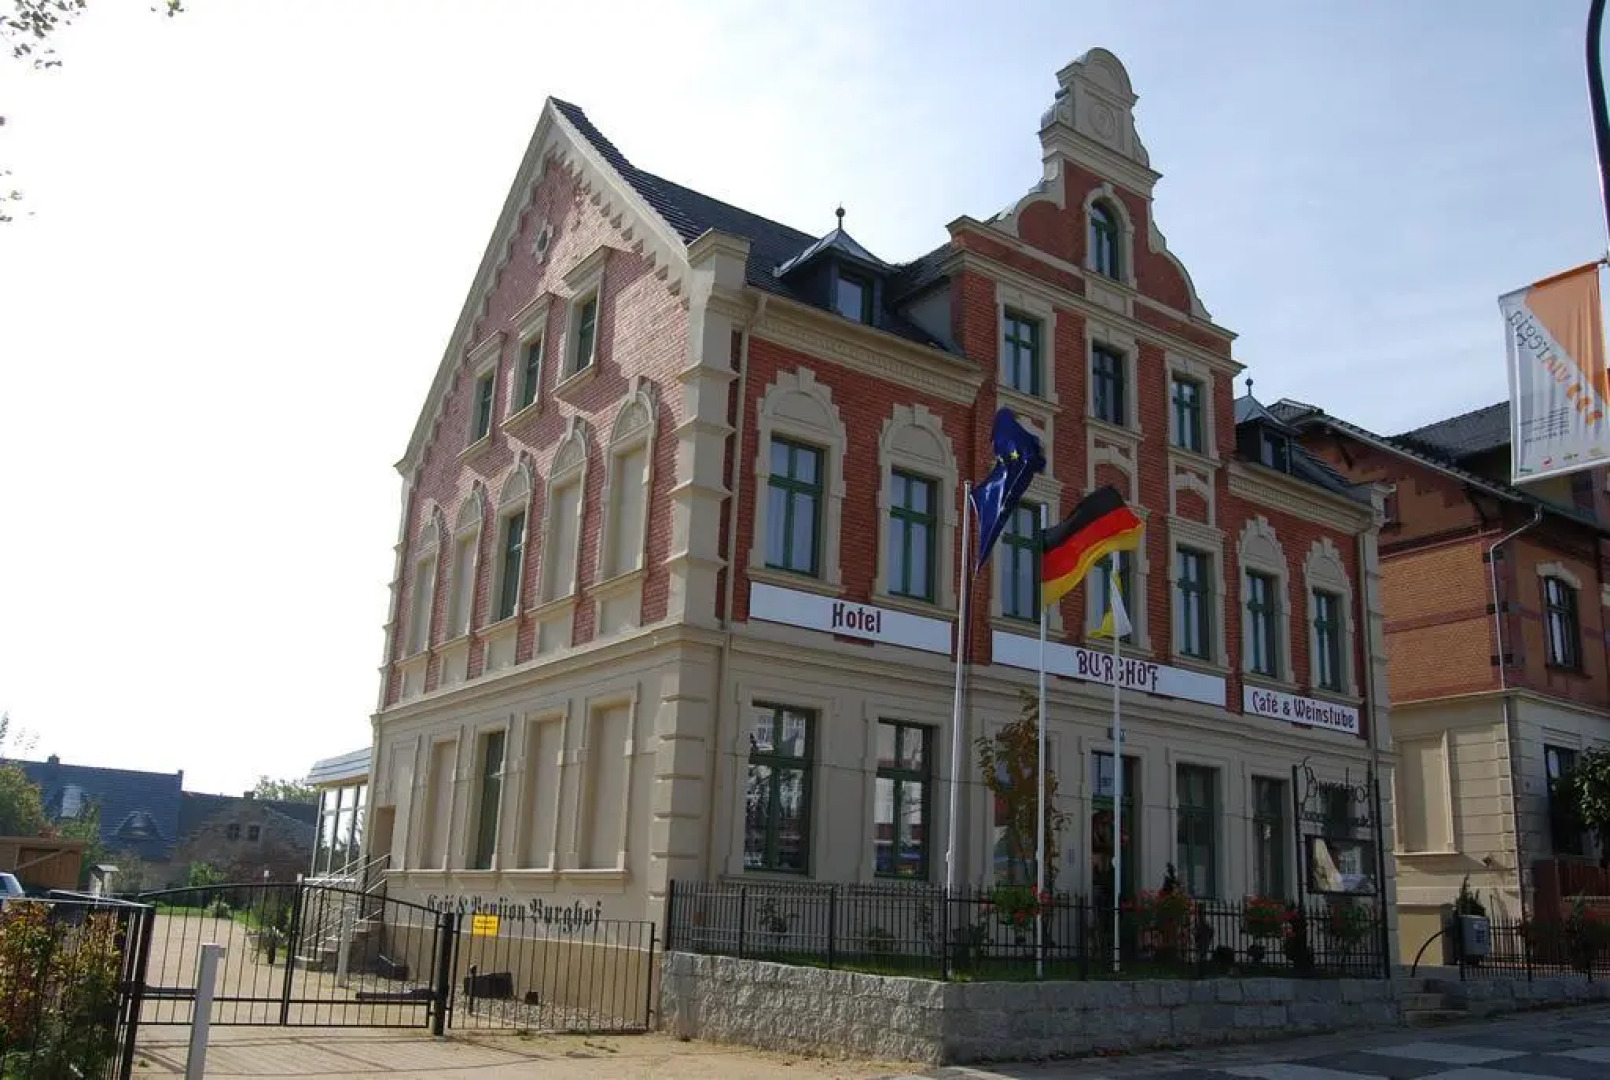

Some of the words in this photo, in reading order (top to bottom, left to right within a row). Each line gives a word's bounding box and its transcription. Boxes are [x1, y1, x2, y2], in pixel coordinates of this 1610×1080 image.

[832, 602, 881, 633] Hotel
[1252, 691, 1279, 713] Café
[1282, 700, 1290, 716] &
[1294, 697, 1355, 729] Weinstube
[527, 897, 602, 934] Burghof
